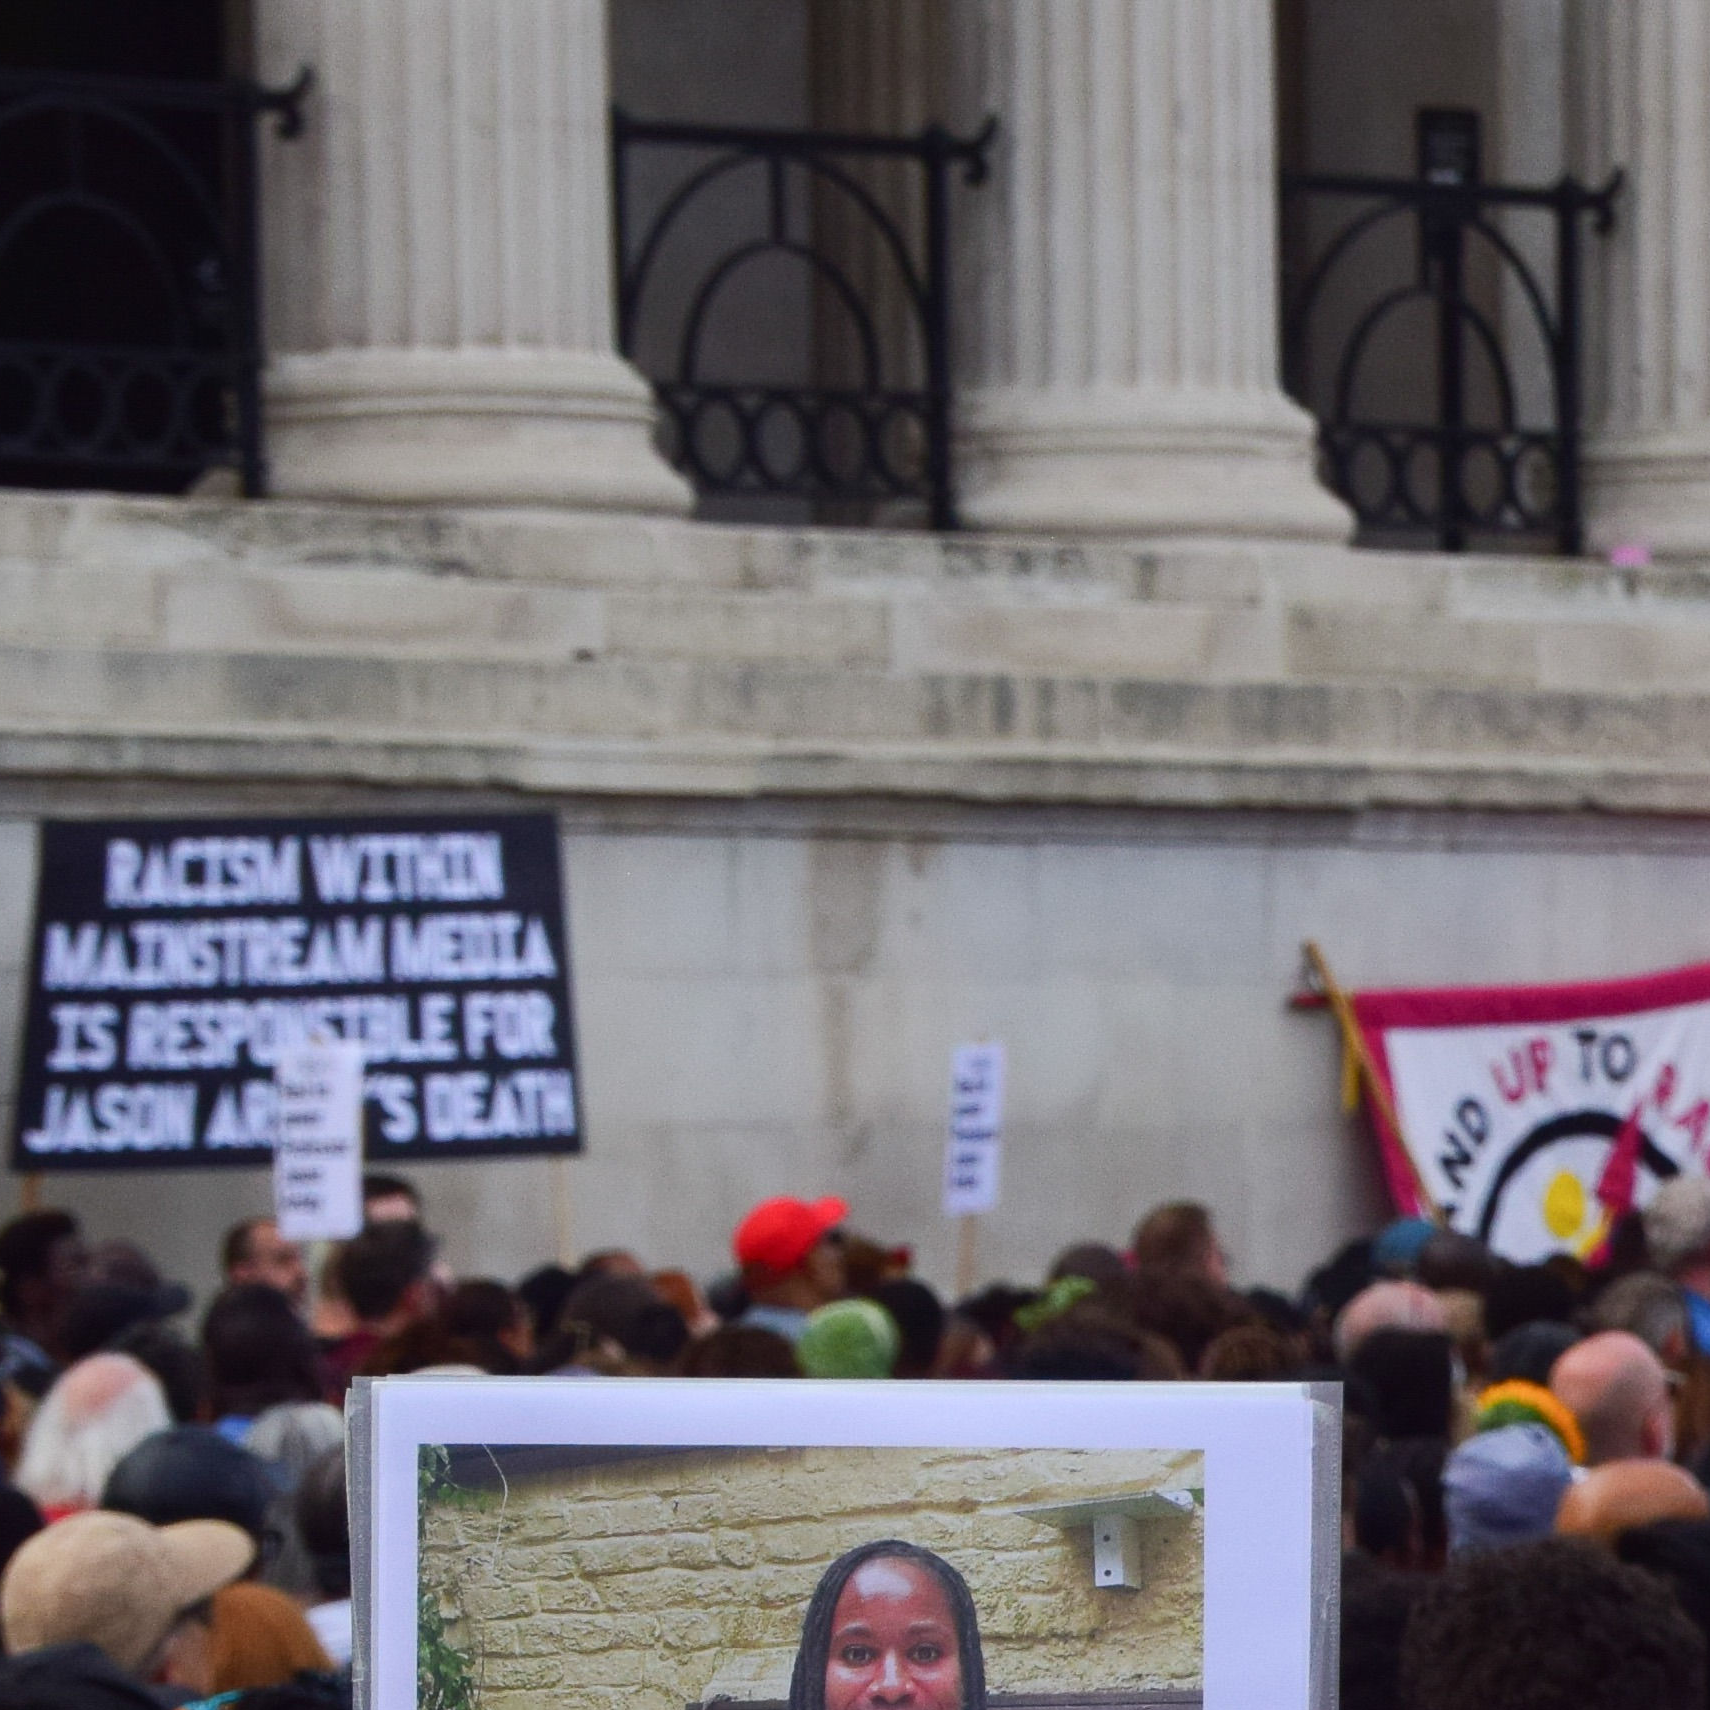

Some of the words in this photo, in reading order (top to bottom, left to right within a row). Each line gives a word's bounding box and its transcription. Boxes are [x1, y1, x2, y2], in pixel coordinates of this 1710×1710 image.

[104, 834, 303, 909] RACISM
[307, 830, 505, 903] WITHIN
[41, 914, 386, 991] MAINSTREAM
[390, 910, 558, 981] MEDIA
[46, 1001, 121, 1071] IS
[462, 990, 558, 1059] FOR
[1492, 1037, 1551, 1103] UP
[1573, 1026, 1637, 1082] TO
[21, 1081, 197, 1153] JASON
[423, 1068, 576, 1141] DEATH
